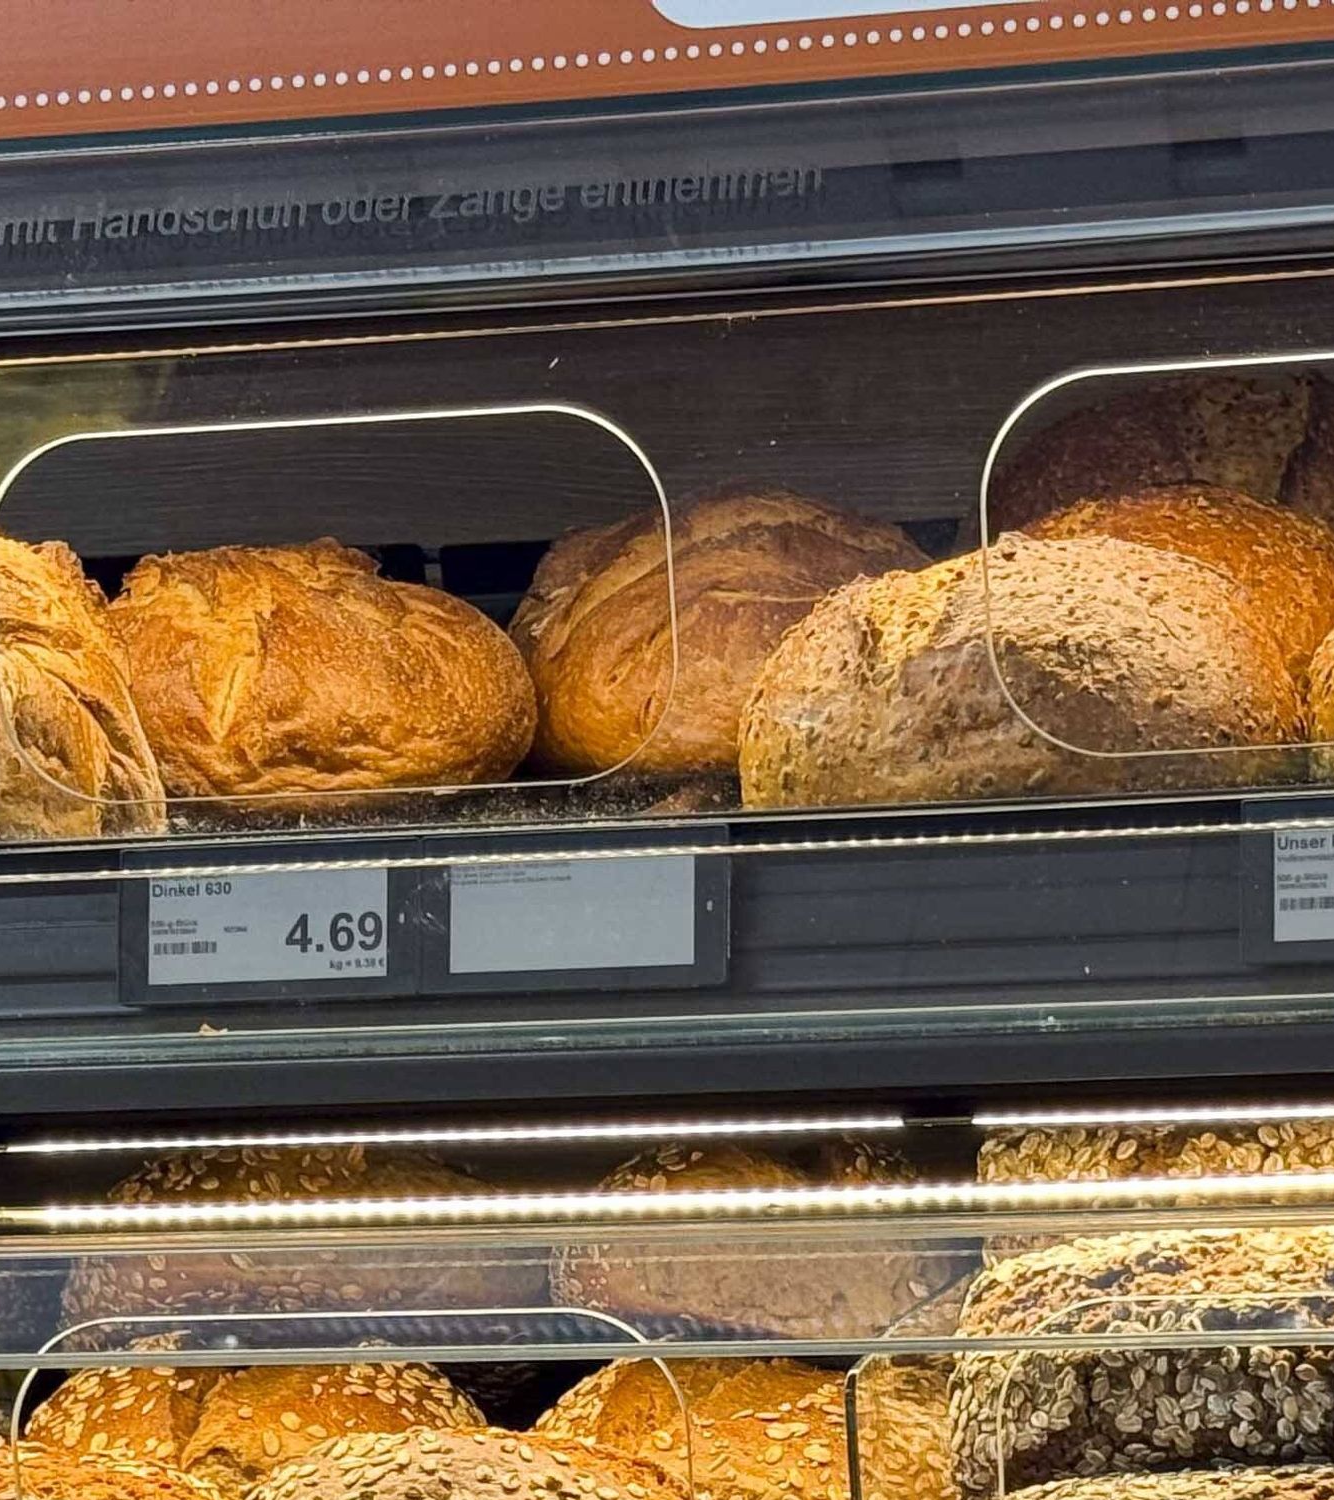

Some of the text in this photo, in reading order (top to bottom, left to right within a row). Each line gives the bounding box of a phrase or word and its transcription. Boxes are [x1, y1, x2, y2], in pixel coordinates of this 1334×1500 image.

[71, 192, 306, 242] Handschuh
[321, 190, 413, 226] oder
[428, 184, 565, 223] Zange
[1277, 836, 1327, 850] Unser
[152, 882, 232, 898] Dinkel 630
[285, 911, 383, 953] 4.69
[329, 960, 343, 971] kg
